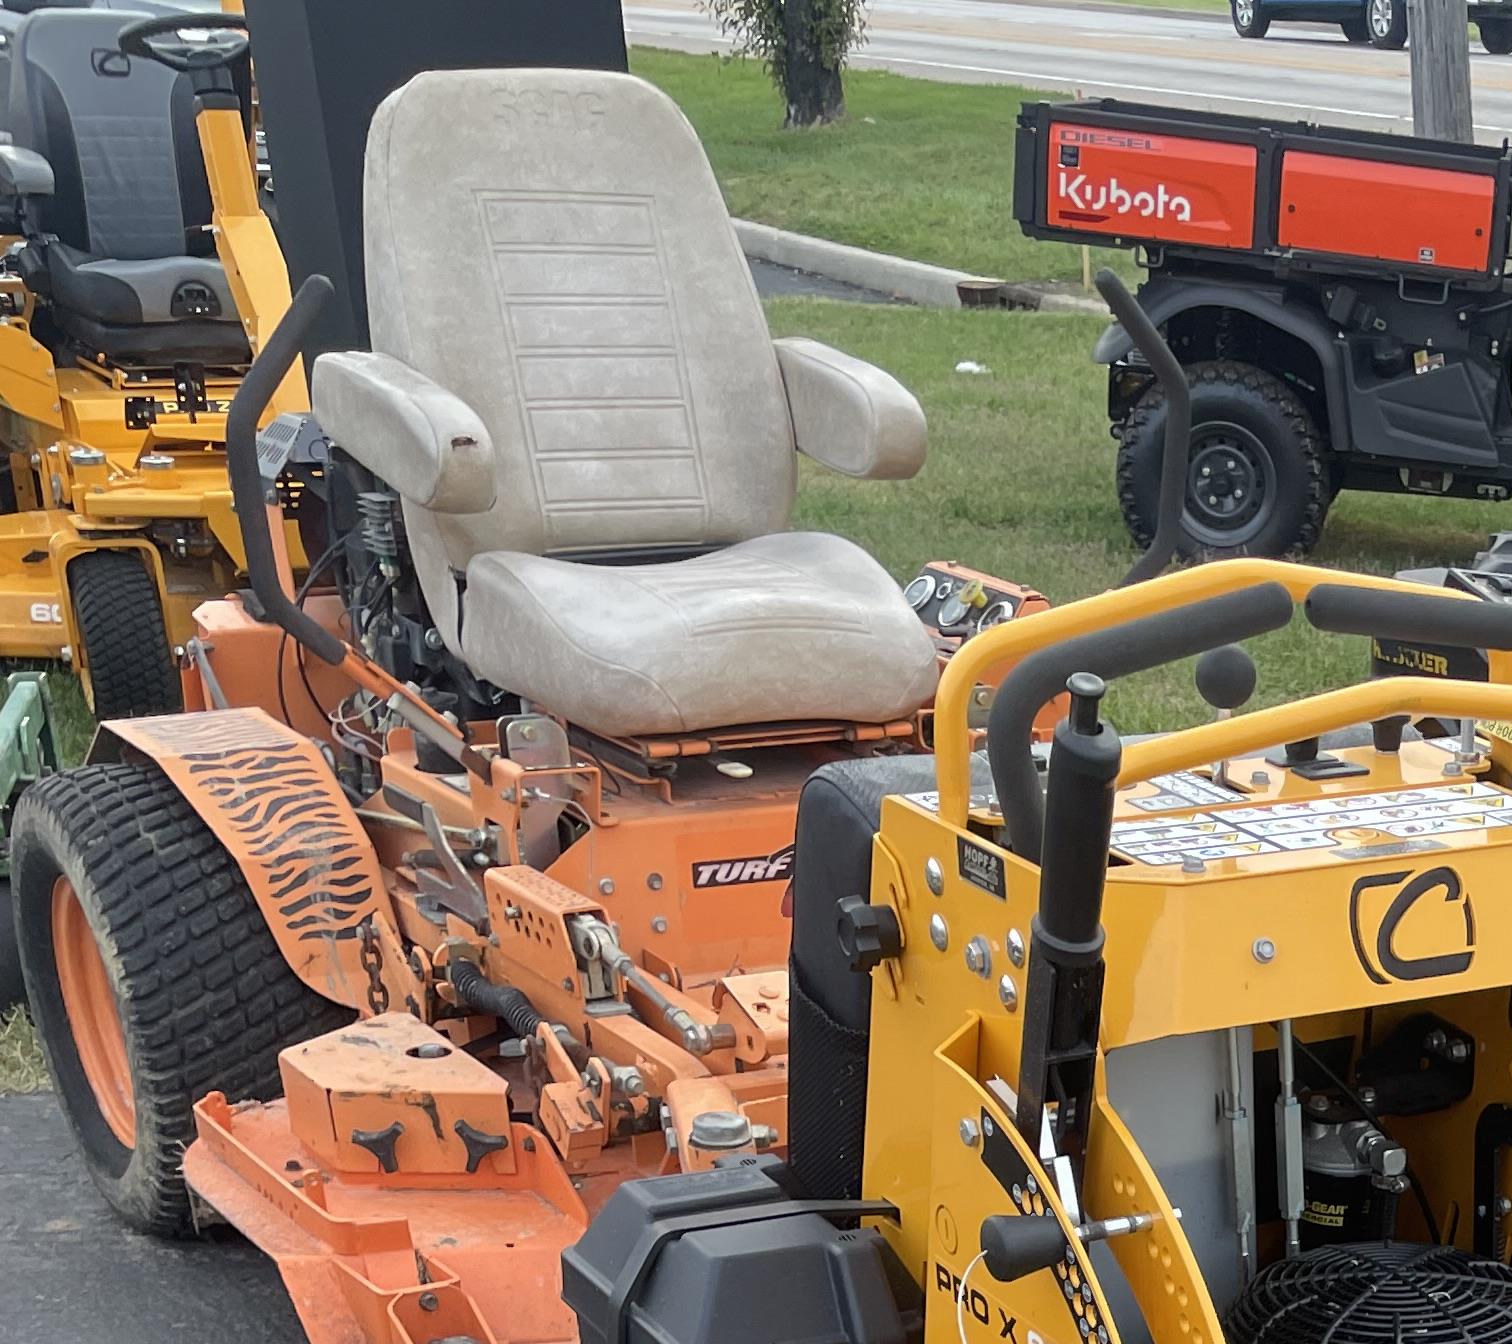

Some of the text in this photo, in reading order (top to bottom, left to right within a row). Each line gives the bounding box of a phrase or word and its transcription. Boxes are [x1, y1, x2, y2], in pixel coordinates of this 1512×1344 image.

[1060, 129, 1163, 152] DIESEL
[1059, 171, 1191, 222] Kubota
[935, 1261, 990, 1326] PRO
